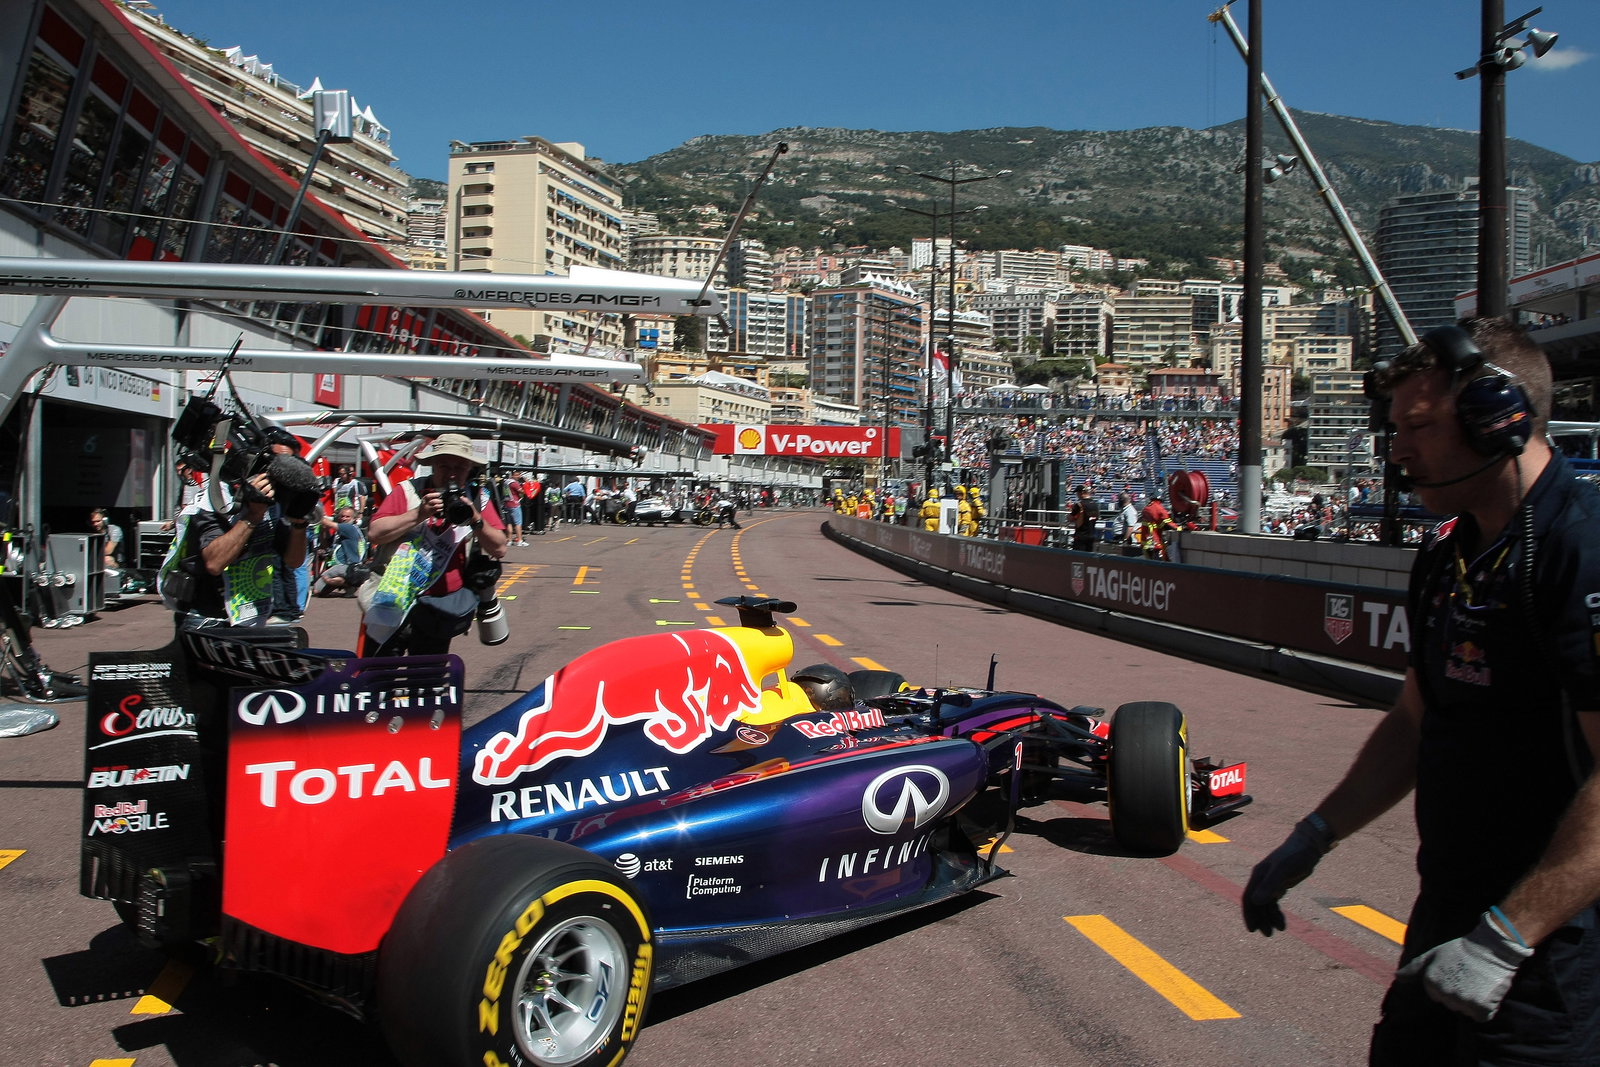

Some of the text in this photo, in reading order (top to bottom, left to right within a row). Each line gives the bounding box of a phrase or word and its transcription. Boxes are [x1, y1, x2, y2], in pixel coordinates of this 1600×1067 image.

[771, 433, 872, 455] V-Power
[1086, 566, 1176, 612] TAGHeuer
[93, 663, 149, 673] SPEED
[99, 694, 187, 737] Servus
[1013, 742, 1023, 770] 1
[245, 757, 450, 808] TOTAL
[490, 766, 671, 822] RENAULT
[88, 812, 170, 837] MOBILE
[643, 857, 673, 872] at&t
[694, 854, 744, 867] SIEMENS
[692, 883, 742, 897] Computing
[693, 875, 734, 887] Platform
[478, 898, 545, 1036] ZERO
[621, 943, 653, 1042] PIRELLI
